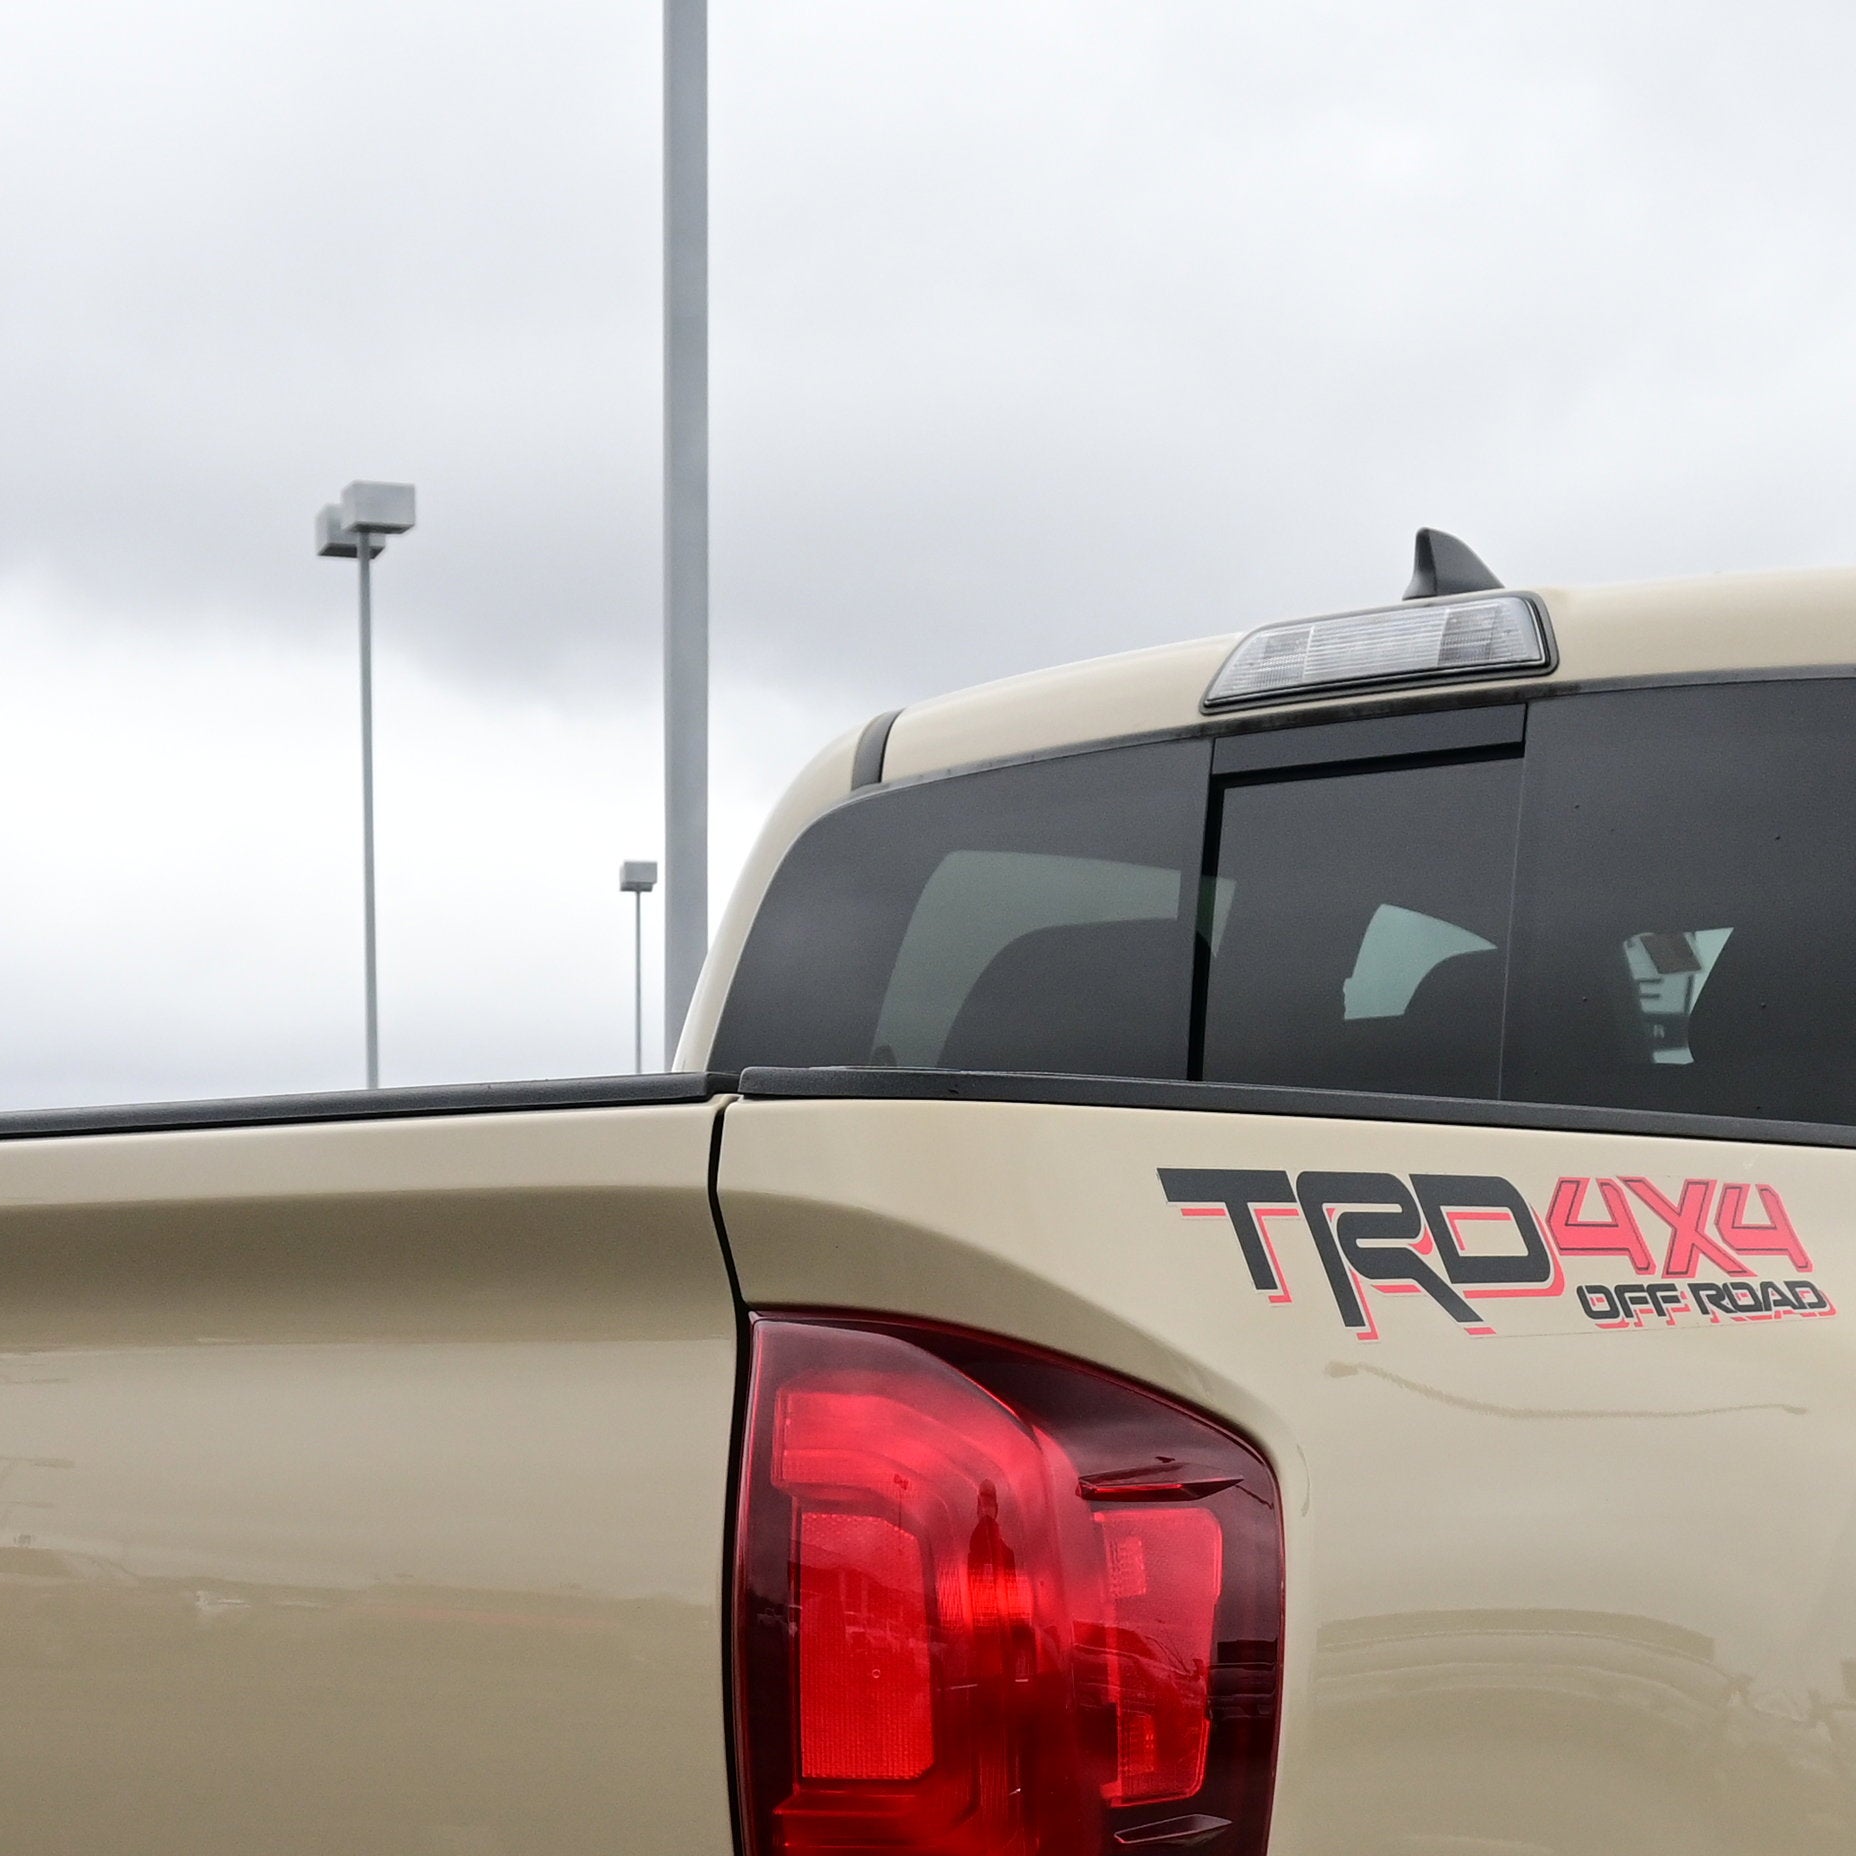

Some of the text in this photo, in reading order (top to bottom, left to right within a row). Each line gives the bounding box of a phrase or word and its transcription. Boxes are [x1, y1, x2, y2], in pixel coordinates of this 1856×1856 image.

[1157, 1167, 1813, 1341] TRD 4X4
[1576, 1280, 1837, 1330] OFF ROAD
